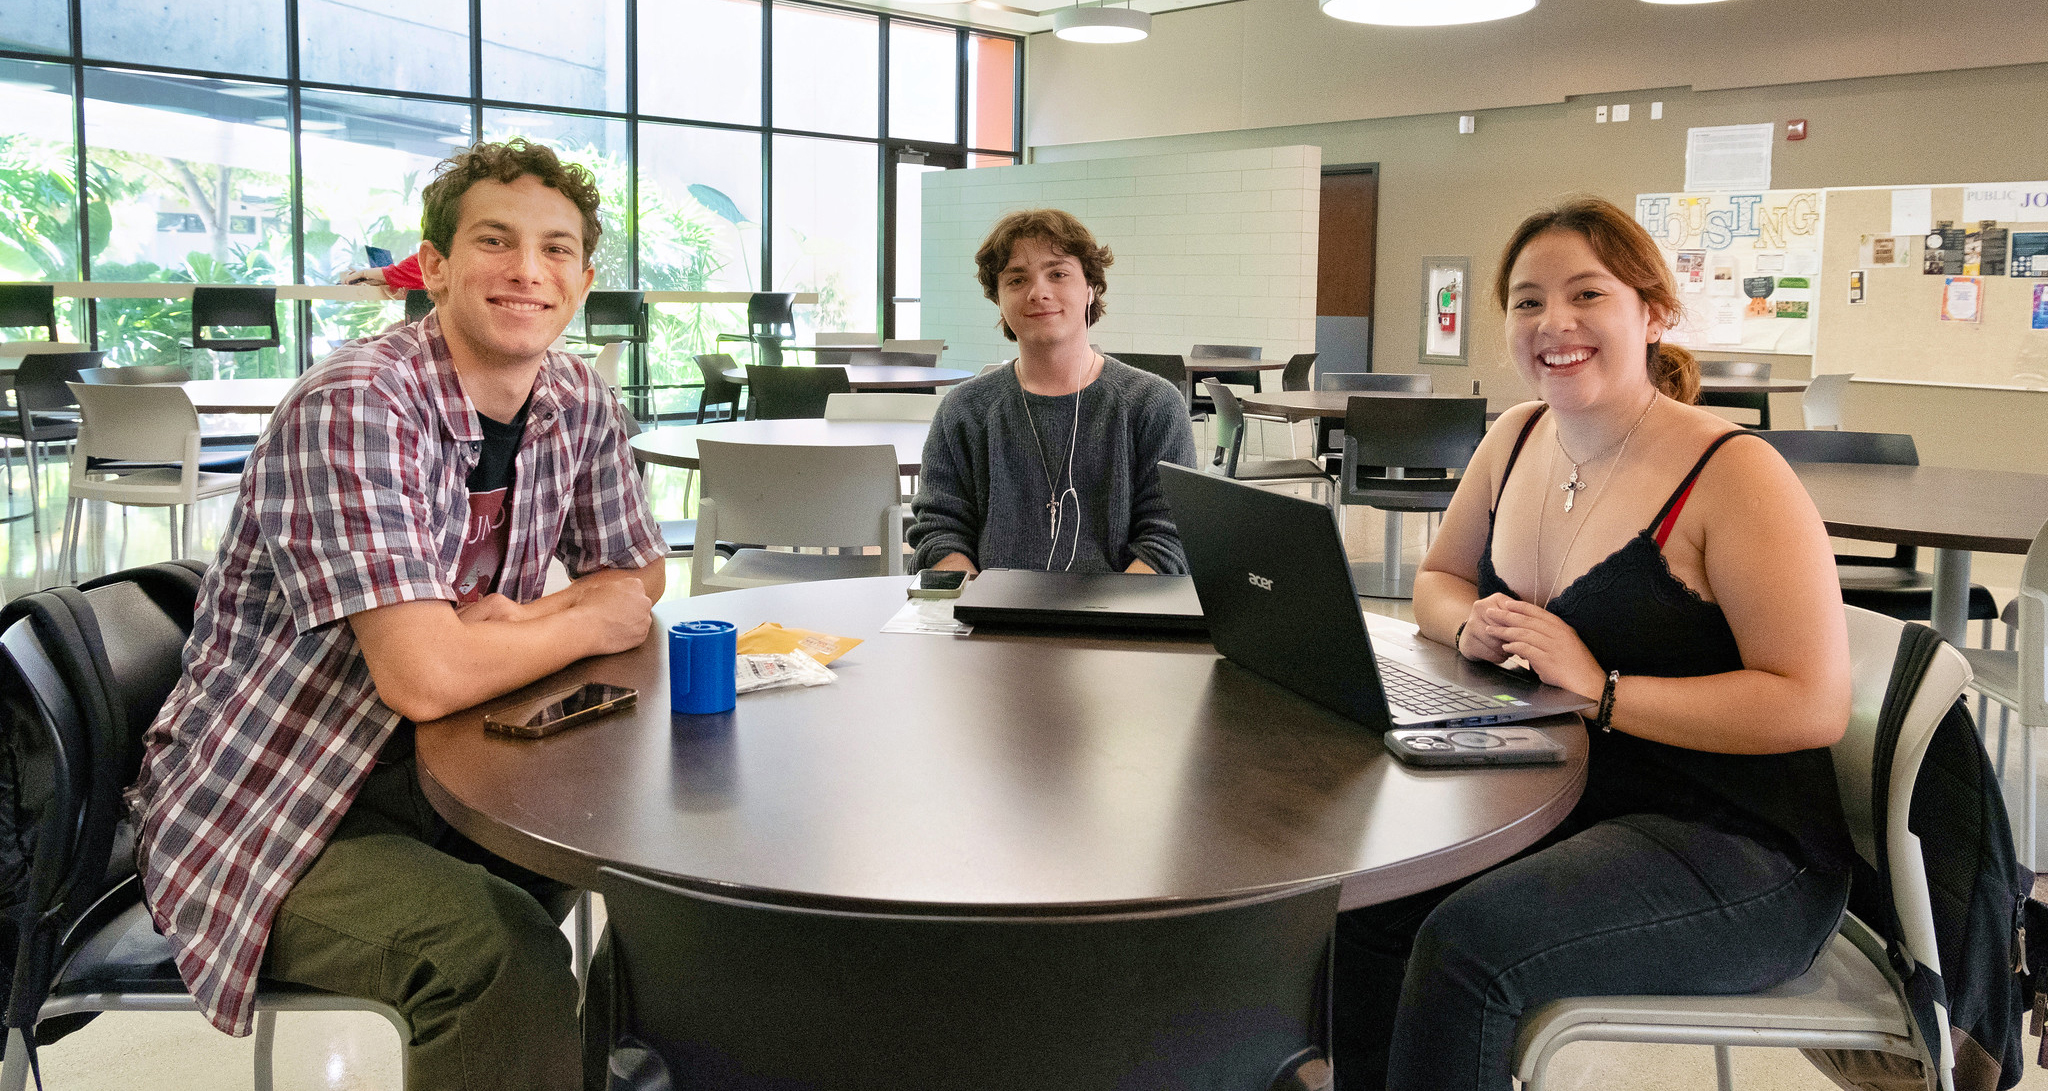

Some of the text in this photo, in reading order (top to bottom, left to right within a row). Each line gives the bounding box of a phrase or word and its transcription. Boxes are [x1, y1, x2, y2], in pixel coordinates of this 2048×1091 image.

[1967, 190, 2016, 201] PUBLIC
[1639, 193, 1819, 250] HOUSING
[1248, 572, 1274, 591] acer
